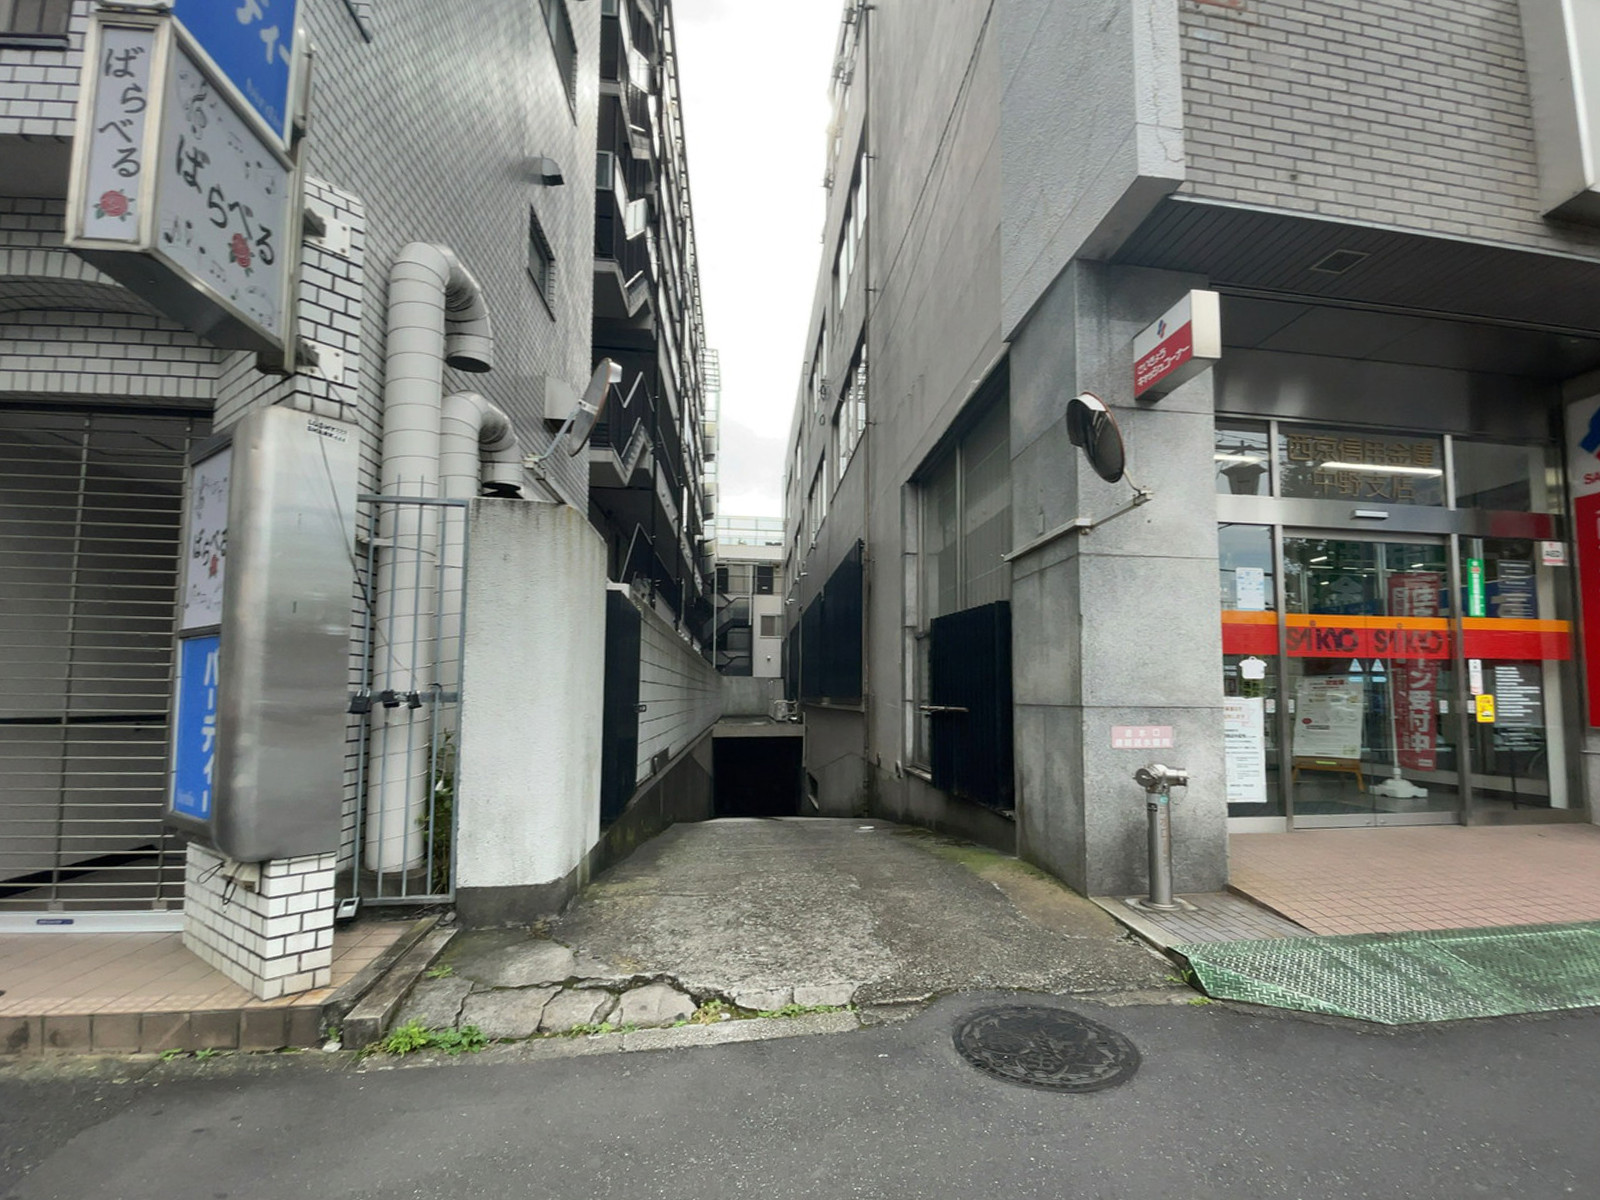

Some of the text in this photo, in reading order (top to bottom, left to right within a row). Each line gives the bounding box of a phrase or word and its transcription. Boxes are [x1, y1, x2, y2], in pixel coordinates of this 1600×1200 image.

[97, 46, 147, 179] ばらべる
[175, 134, 275, 267] ばらべる
[1286, 433, 1434, 467] 西京信用金庫
[1312, 467, 1416, 501] 中野支店
